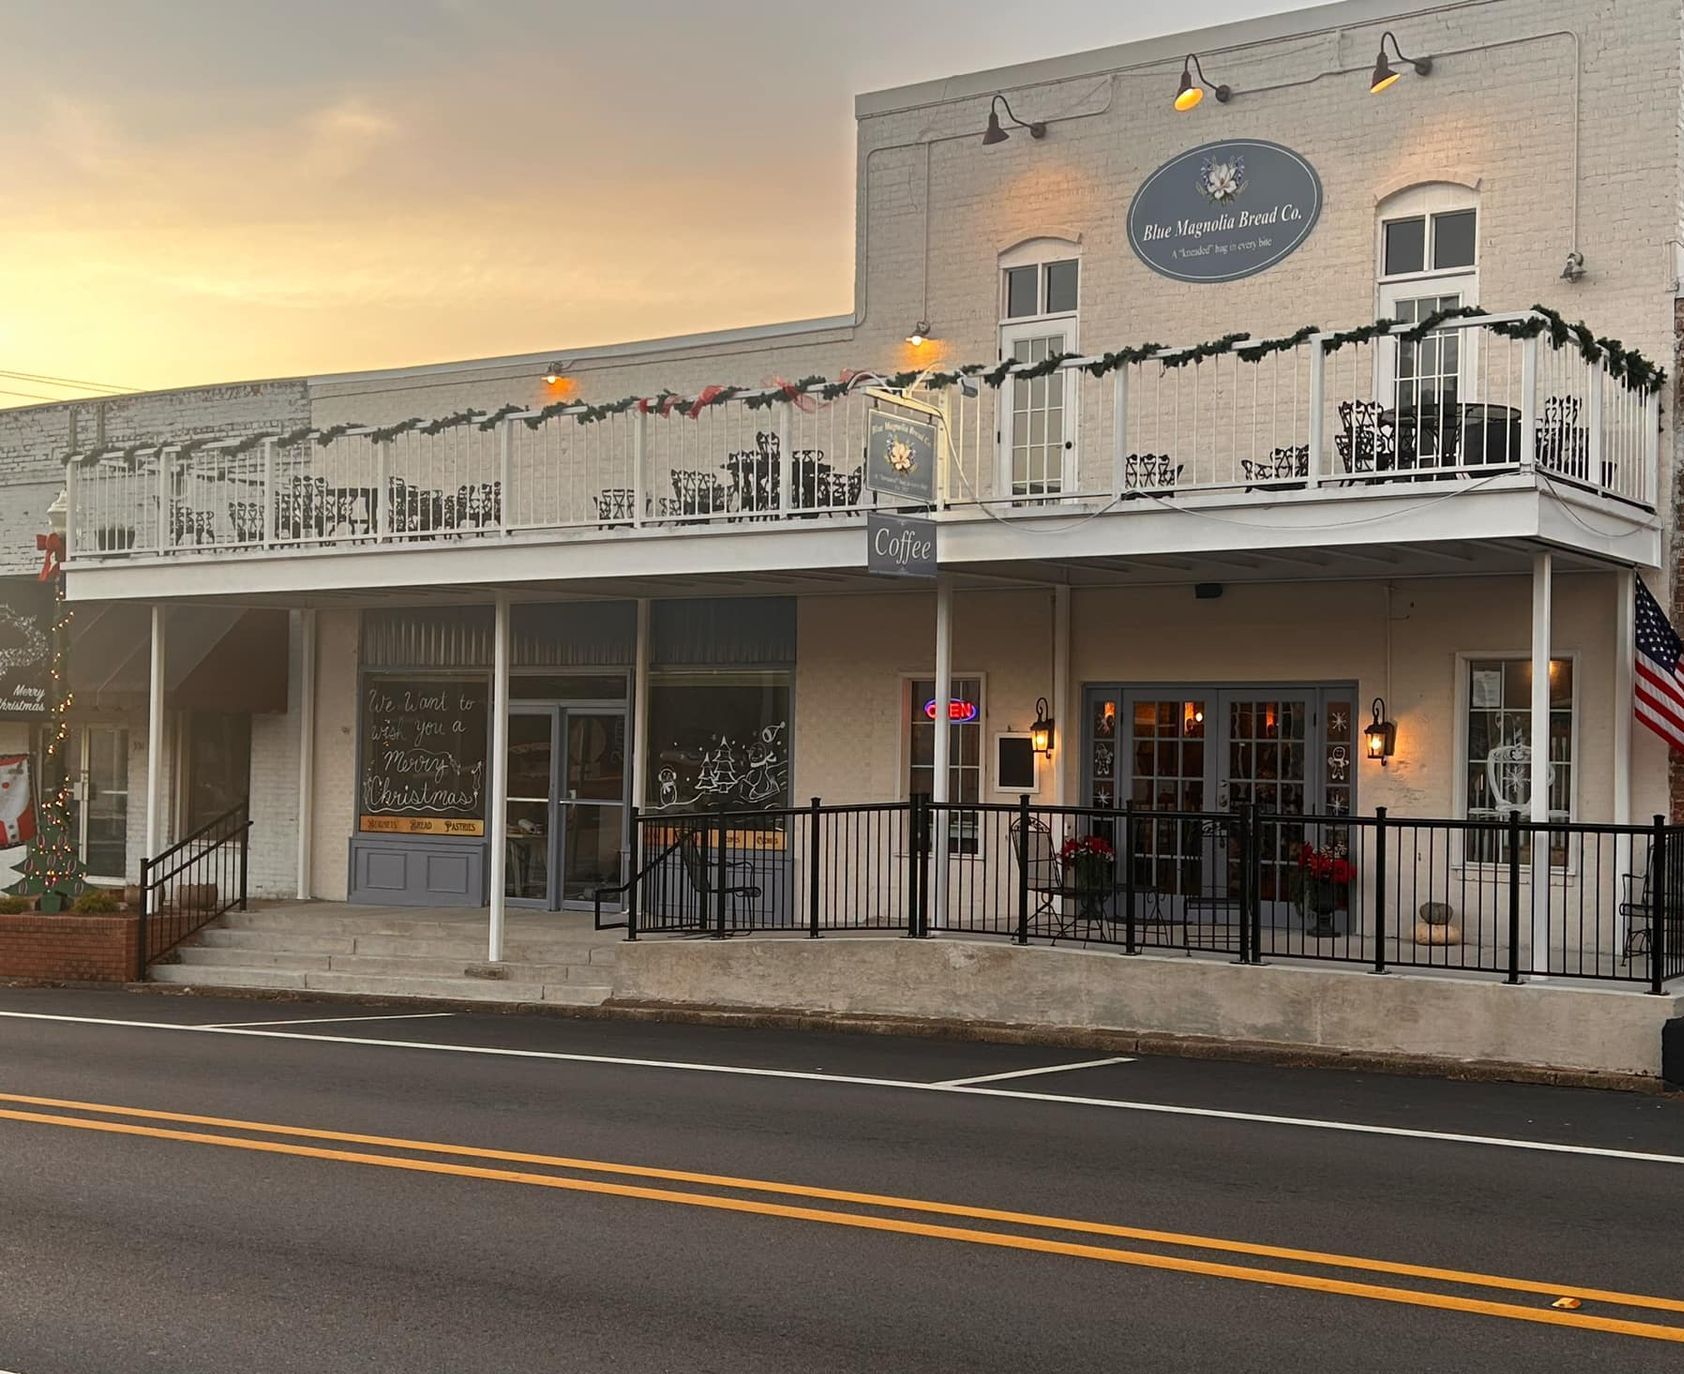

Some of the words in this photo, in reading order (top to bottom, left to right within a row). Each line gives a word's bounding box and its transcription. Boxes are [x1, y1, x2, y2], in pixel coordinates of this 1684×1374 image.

[1143, 224, 1172, 241] Blue
[1175, 213, 1235, 239] Magnolia
[1239, 206, 1279, 227] Bread
[1281, 204, 1302, 221] Co.
[1171, 249, 1178, 260] A
[1214, 244, 1229, 255] hug
[1237, 240, 1257, 251] every
[1258, 237, 1273, 248] bite
[875, 527, 931, 564] Coffee
[13, 684, 46, 700] Merry
[369, 689, 396, 712] We
[404, 689, 448, 712] Want
[459, 694, 476, 711] to
[926, 703, 972, 719] OEN
[371, 717, 406, 741] wish
[415, 720, 445, 747] you
[452, 720, 467, 733] a
[384, 749, 449, 784] Merry
[367, 775, 474, 806] Christmas
[444, 821, 476, 832] PASTRIES
